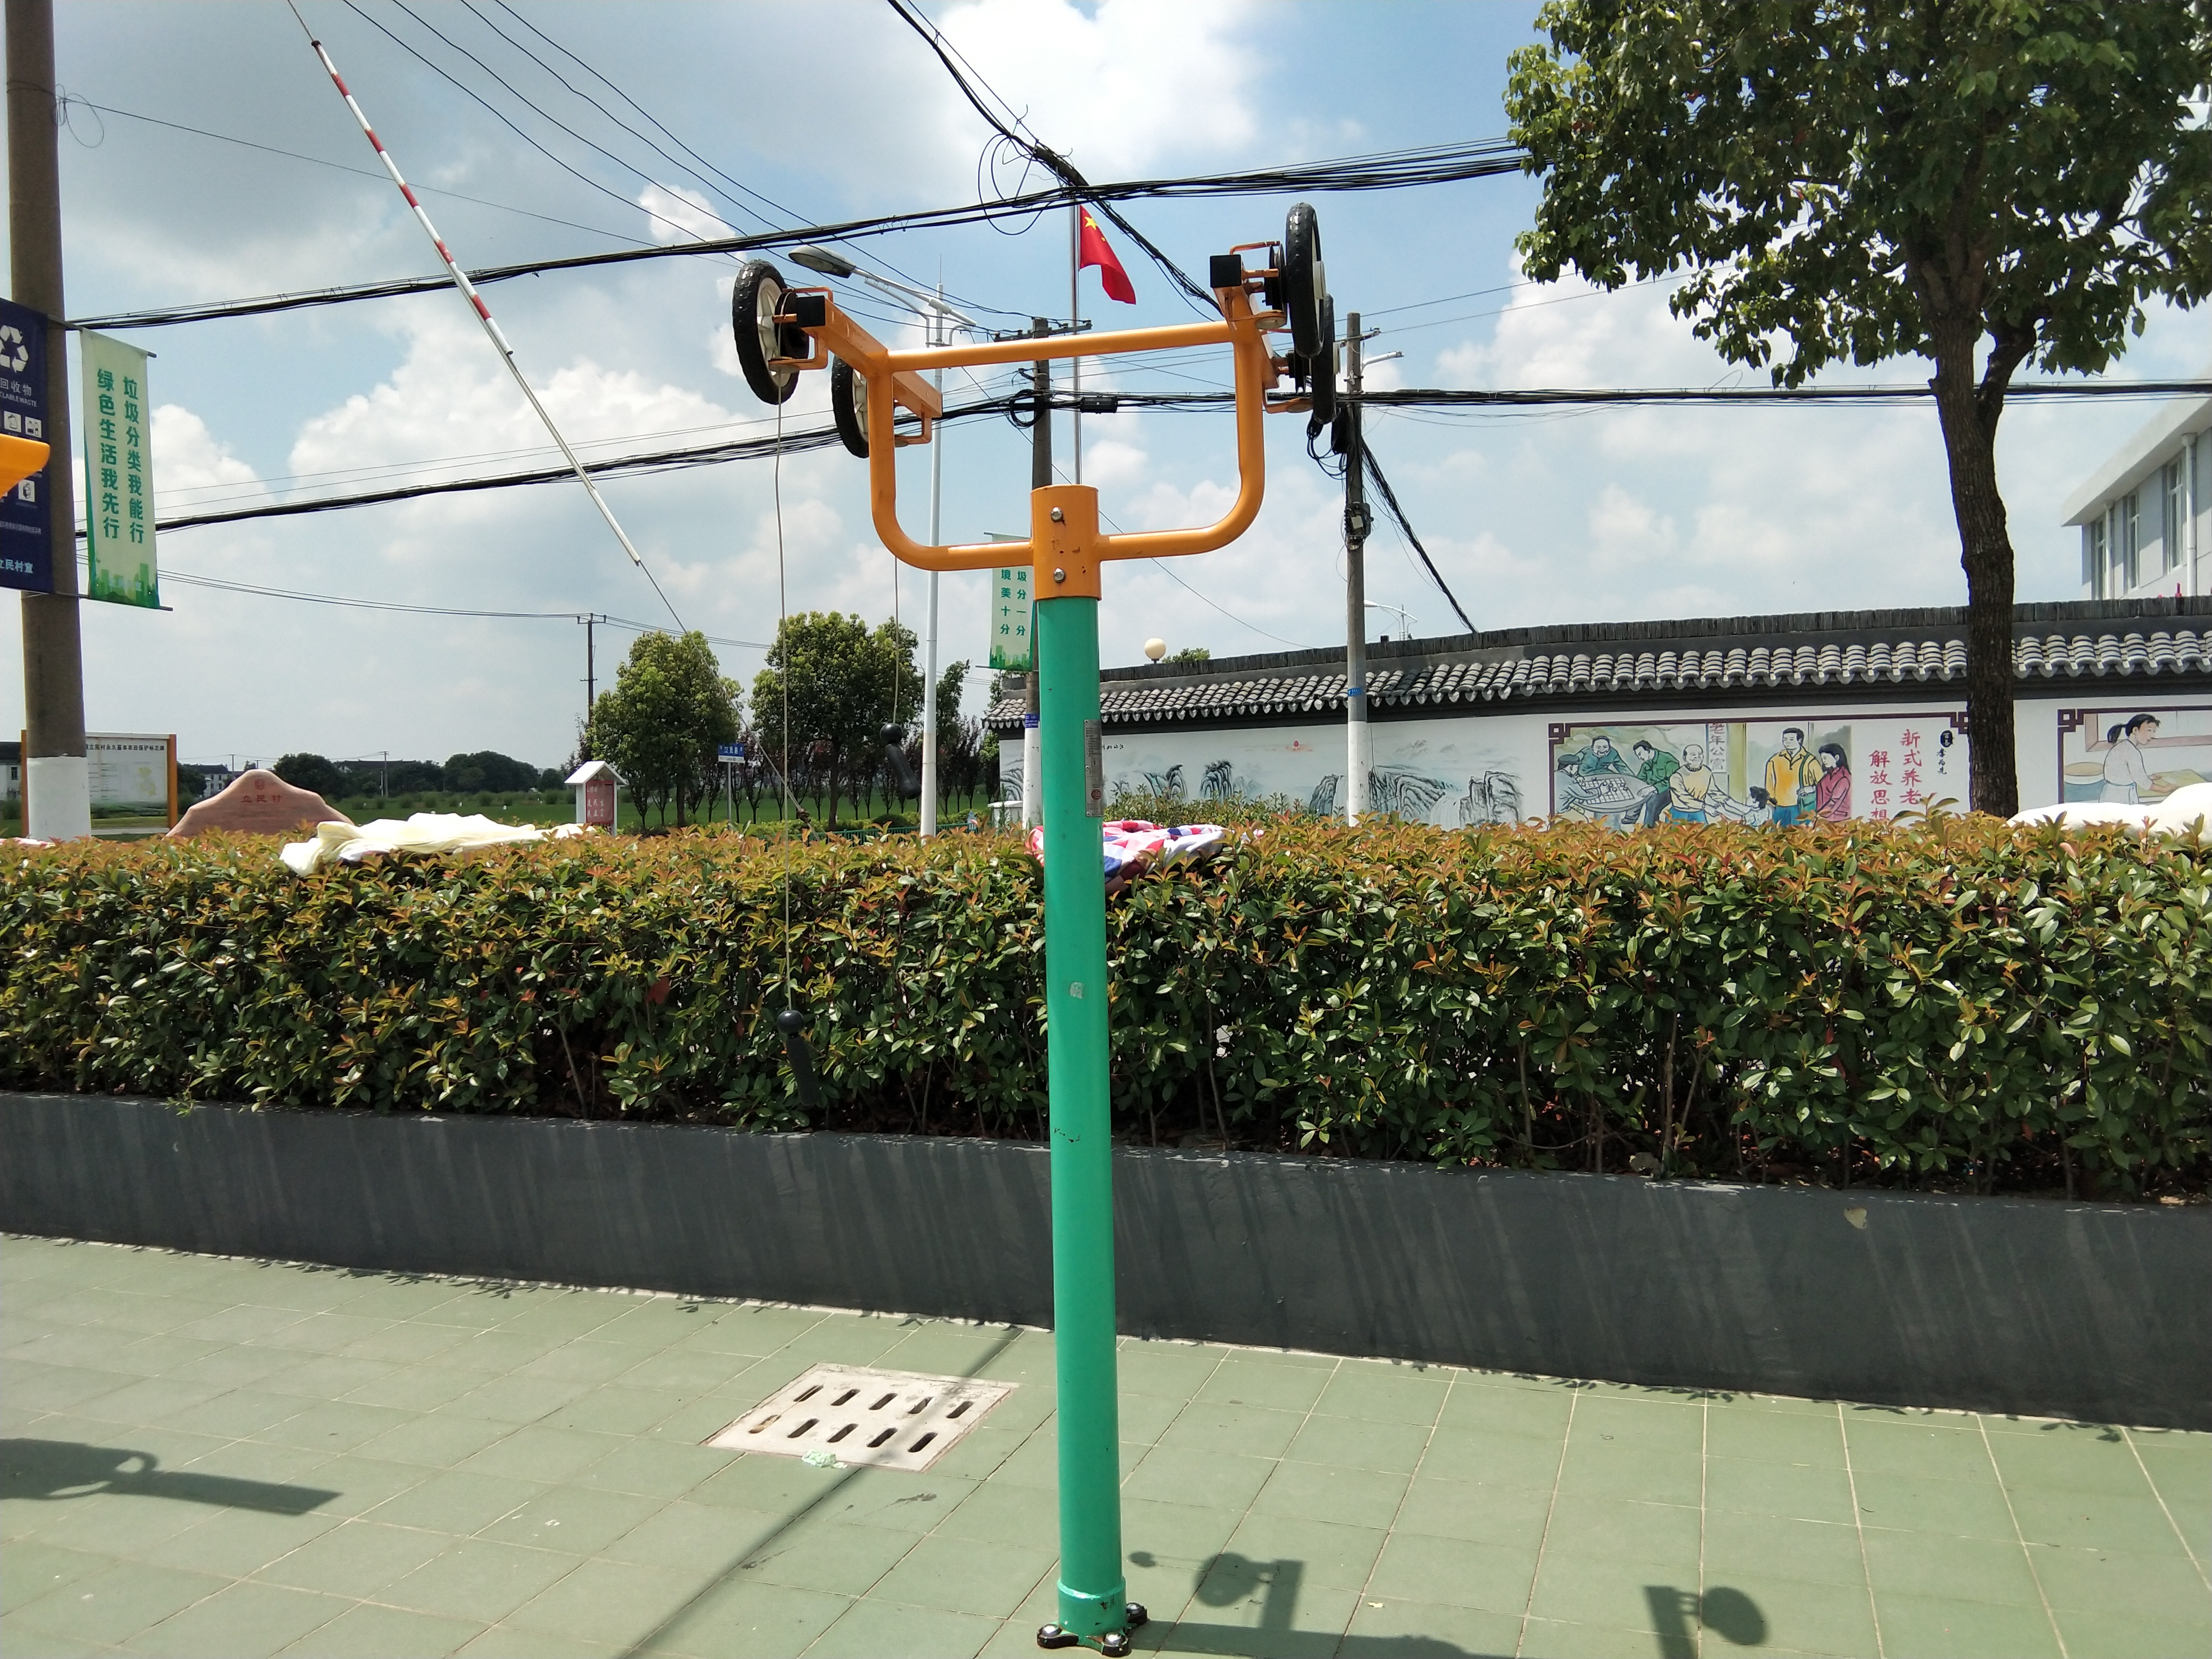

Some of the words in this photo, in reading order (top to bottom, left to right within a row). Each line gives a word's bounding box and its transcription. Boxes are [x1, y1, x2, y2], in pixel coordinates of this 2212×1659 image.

[0, 378, 32, 396] 回收物
[19, 397, 38, 407] WASTE
[97, 368, 119, 539] 绿色生活我先行
[123, 376, 144, 543] 垃圾分类我能行
[1000, 569, 1011, 634] 境美十分
[1016, 571, 1027, 636] 圾分一分
[241, 794, 281, 803] 立民村
[1899, 729, 1922, 805] 新式养老
